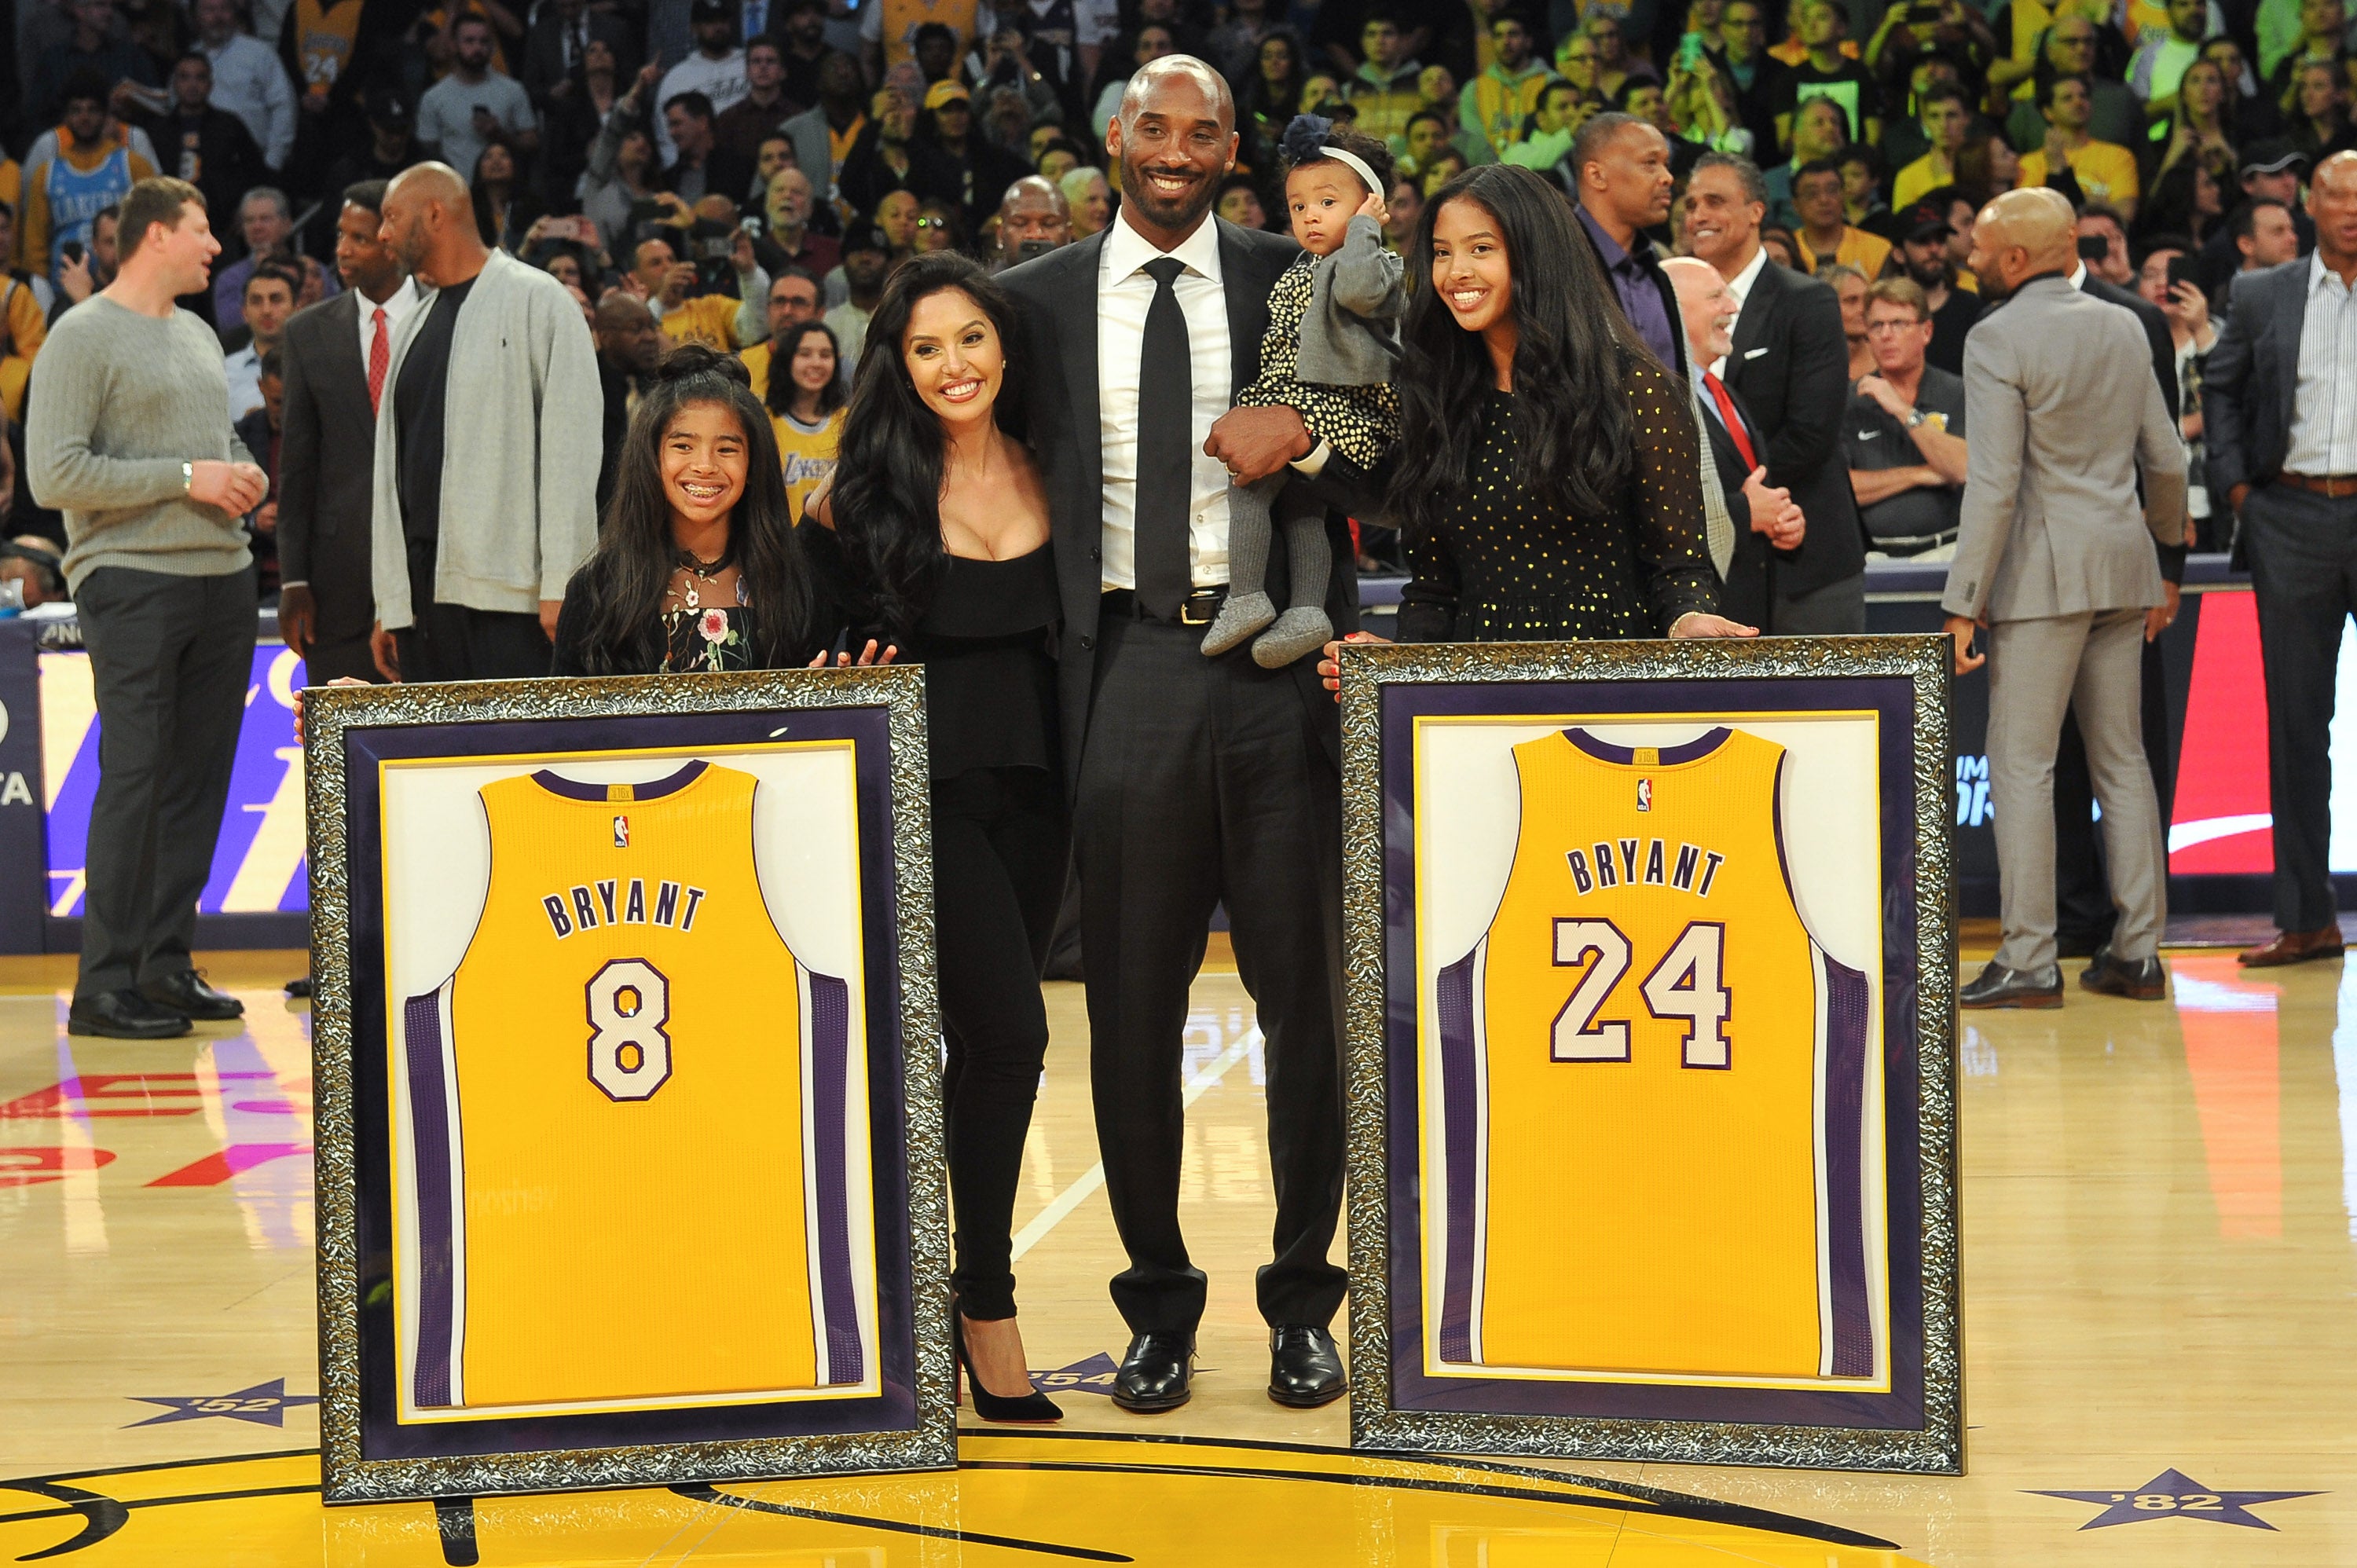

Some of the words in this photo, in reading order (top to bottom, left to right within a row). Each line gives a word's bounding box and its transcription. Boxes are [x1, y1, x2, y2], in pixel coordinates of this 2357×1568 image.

[1564, 837, 1726, 899] BRYANT
[541, 877, 706, 940] BRYANT
[1550, 917, 1732, 1071] 24
[585, 957, 673, 1102] 8
[2110, 1493, 2224, 1511] '82
